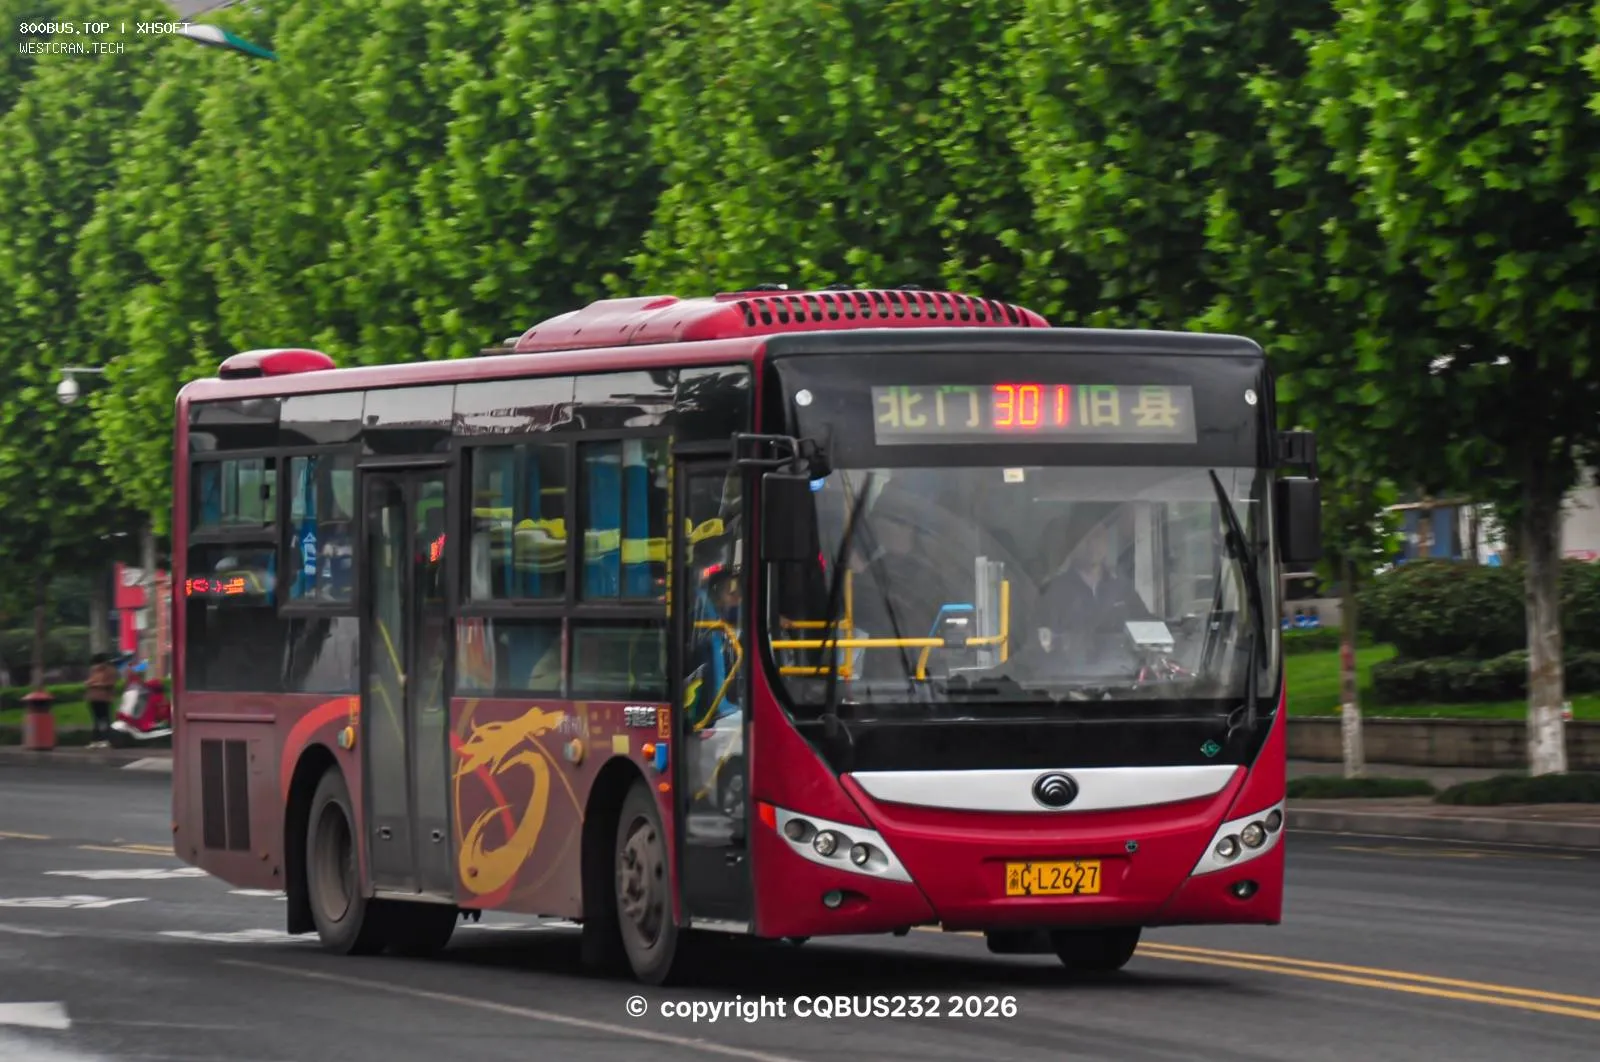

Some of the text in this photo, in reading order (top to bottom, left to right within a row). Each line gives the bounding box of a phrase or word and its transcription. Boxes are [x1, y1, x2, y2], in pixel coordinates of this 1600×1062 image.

[878, 384, 1181, 427] 北门 301 旧县
